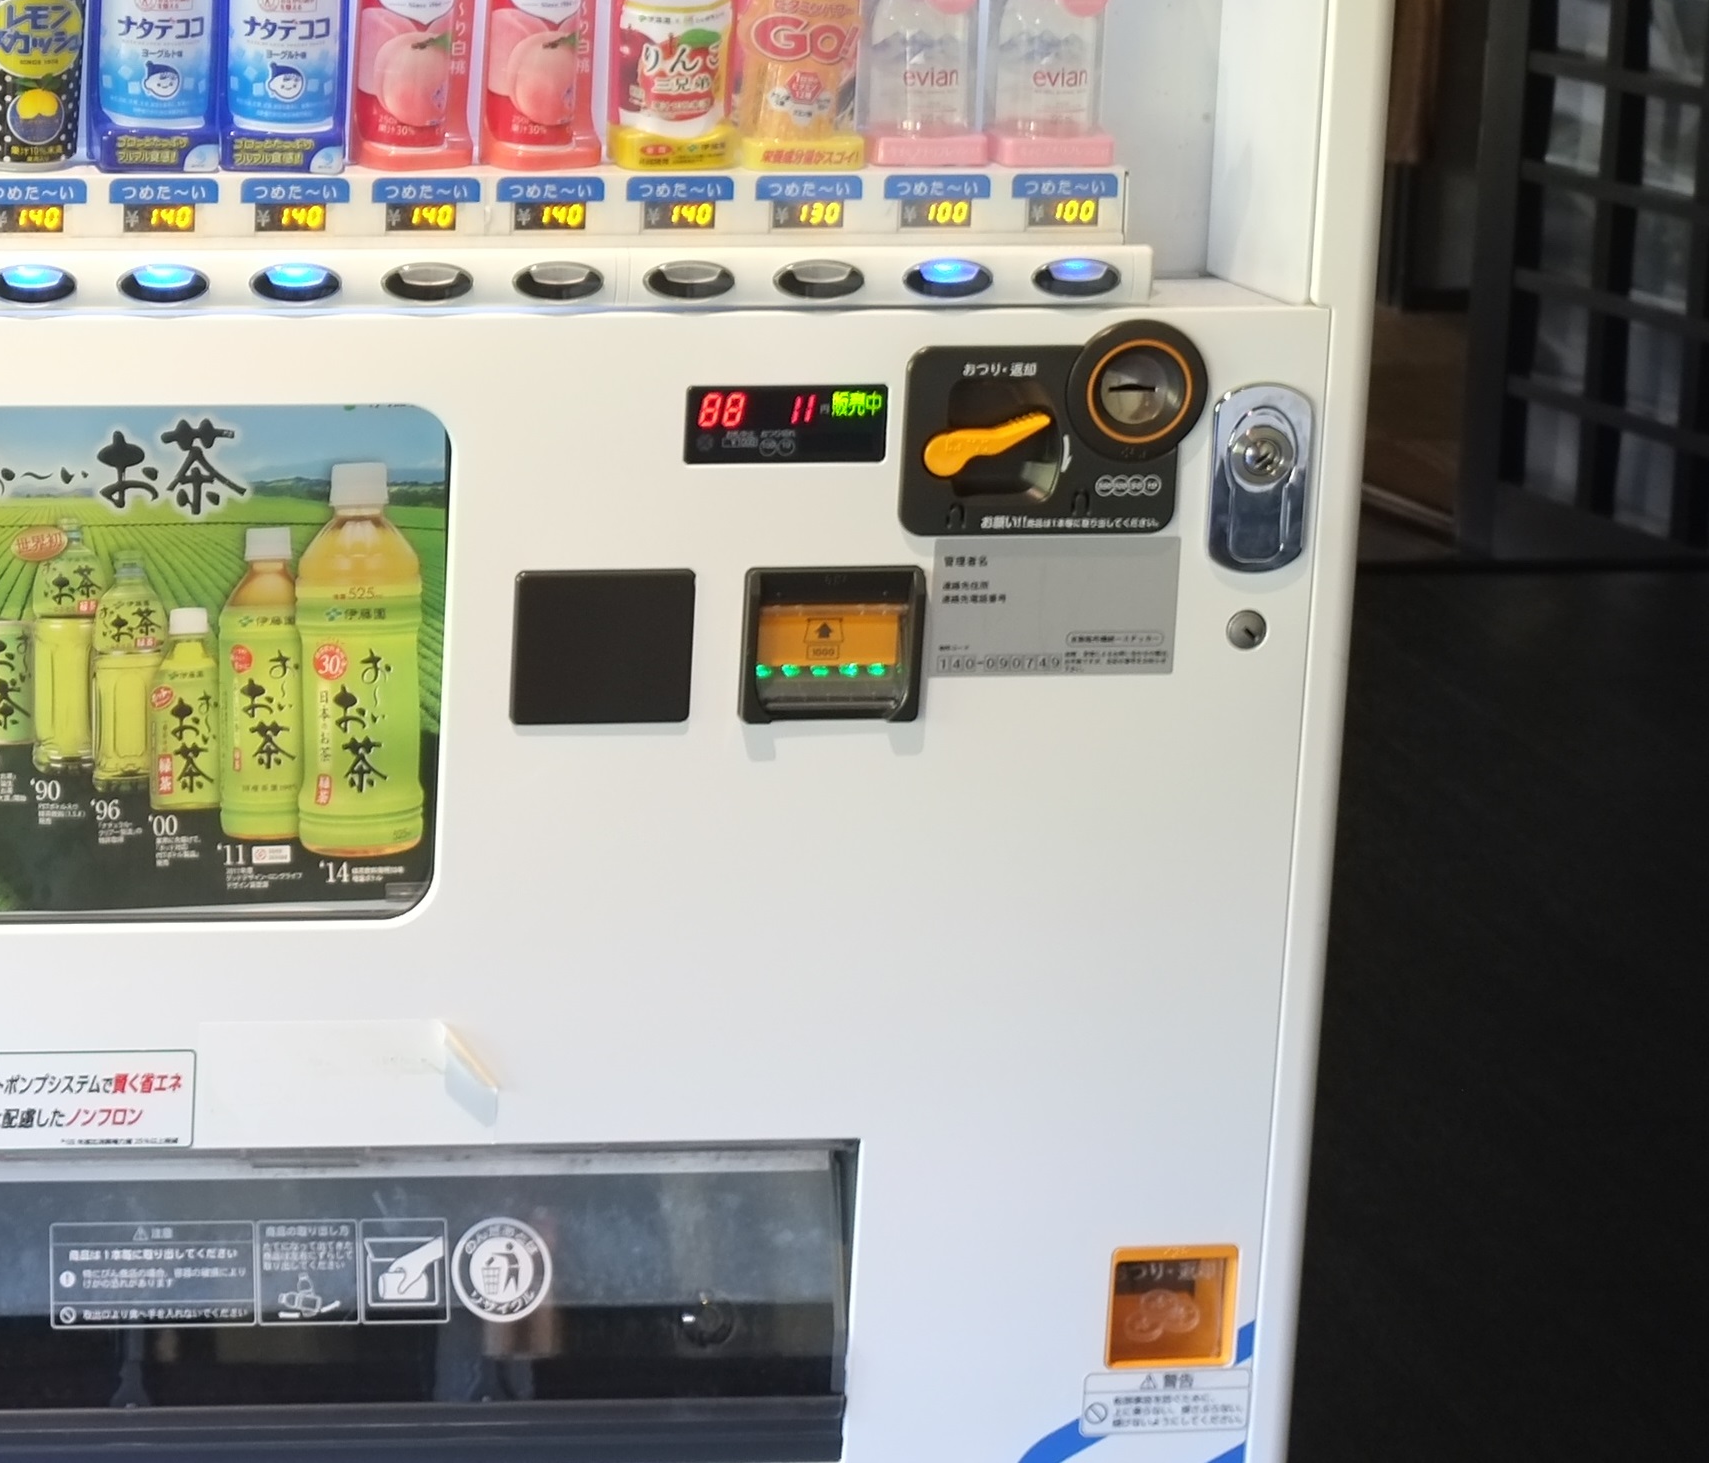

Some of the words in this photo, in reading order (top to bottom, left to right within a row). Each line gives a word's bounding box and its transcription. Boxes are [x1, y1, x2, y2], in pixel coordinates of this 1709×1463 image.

[7, 5, 72, 30] レモン
[118, 16, 204, 40] ナタデココ
[243, 17, 330, 40] ナタデココ
[753, 14, 860, 65] GO!
[142, 49, 183, 59] ヨーグルト味
[903, 68, 959, 87] evian
[1033, 68, 1088, 87] evian
[962, 362, 1038, 377] おつり・返却
[831, 390, 883, 417] 販売中
[14, 533, 65, 555] 世界初
[344, 607, 387, 621] 伊藤園
